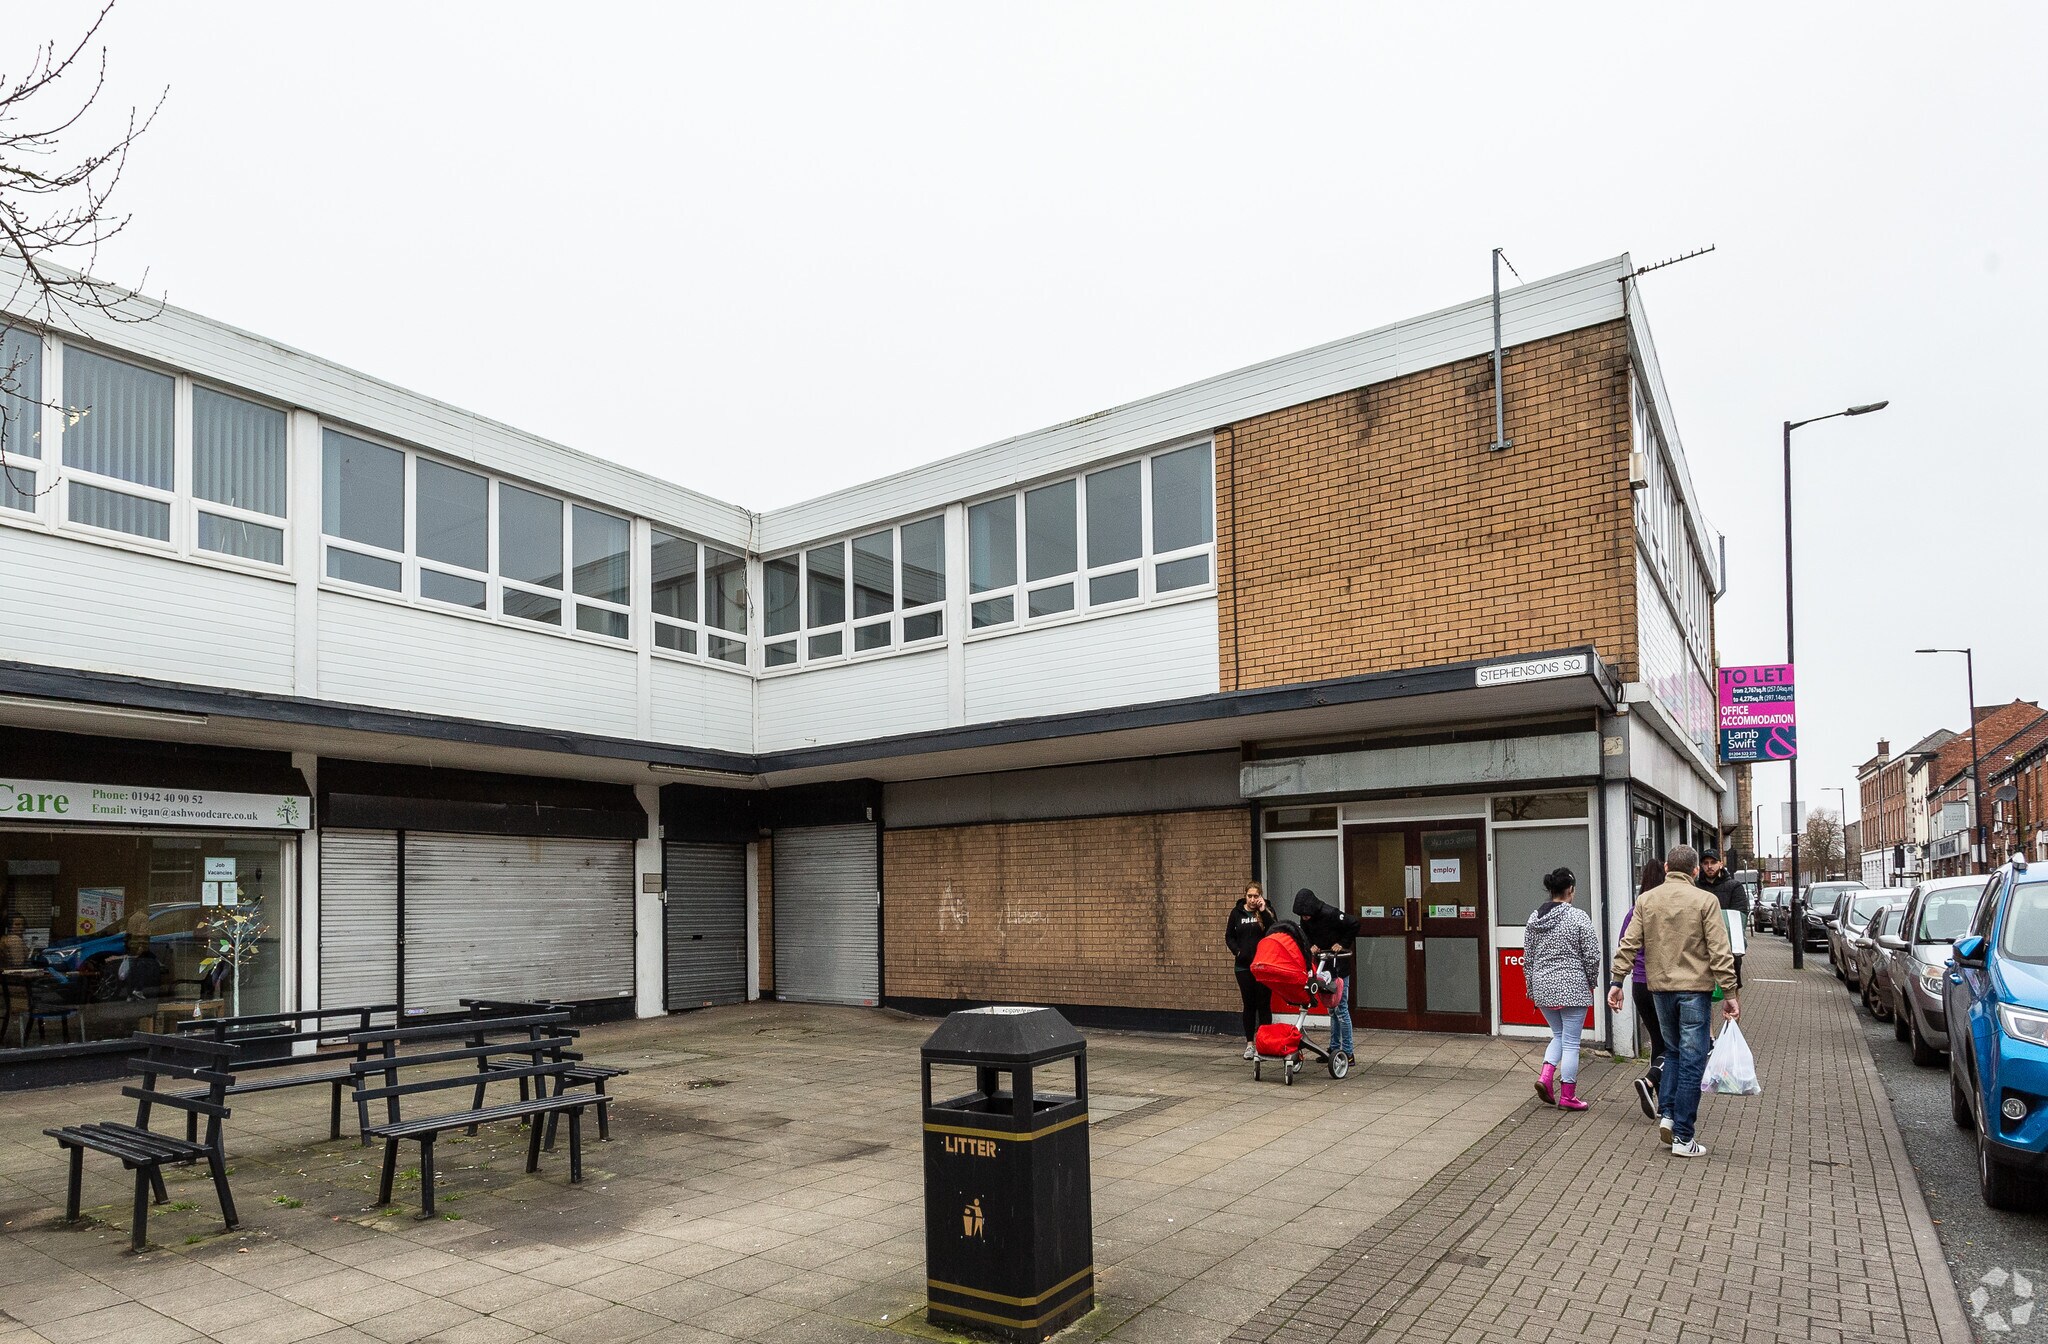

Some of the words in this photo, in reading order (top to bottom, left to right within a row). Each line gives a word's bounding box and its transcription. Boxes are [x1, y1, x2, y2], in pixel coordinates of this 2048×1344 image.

[1480, 662, 1559, 682] STEPHENSONS
[1563, 659, 1583, 671] SQ.
[1721, 669, 1747, 684] TO
[1754, 667, 1786, 683] LET
[1721, 705, 1749, 716] OFFICE
[1721, 714, 1794, 726] ACCOMMODATION
[1728, 729, 1759, 740] Lamb
[1728, 739, 1757, 749] Swift
[92, 789, 128, 800] Phone:
[131, 792, 161, 802] 01942
[164, 793, 175, 803] 40
[178, 794, 189, 803] 90
[192, 794, 203, 804] 52
[92, 803, 127, 815] Email:
[130, 806, 258, 821] wigan@ashwoodcare.co.uk
[1433, 866, 1457, 875] employ
[945, 1135, 997, 1158] LITTER
